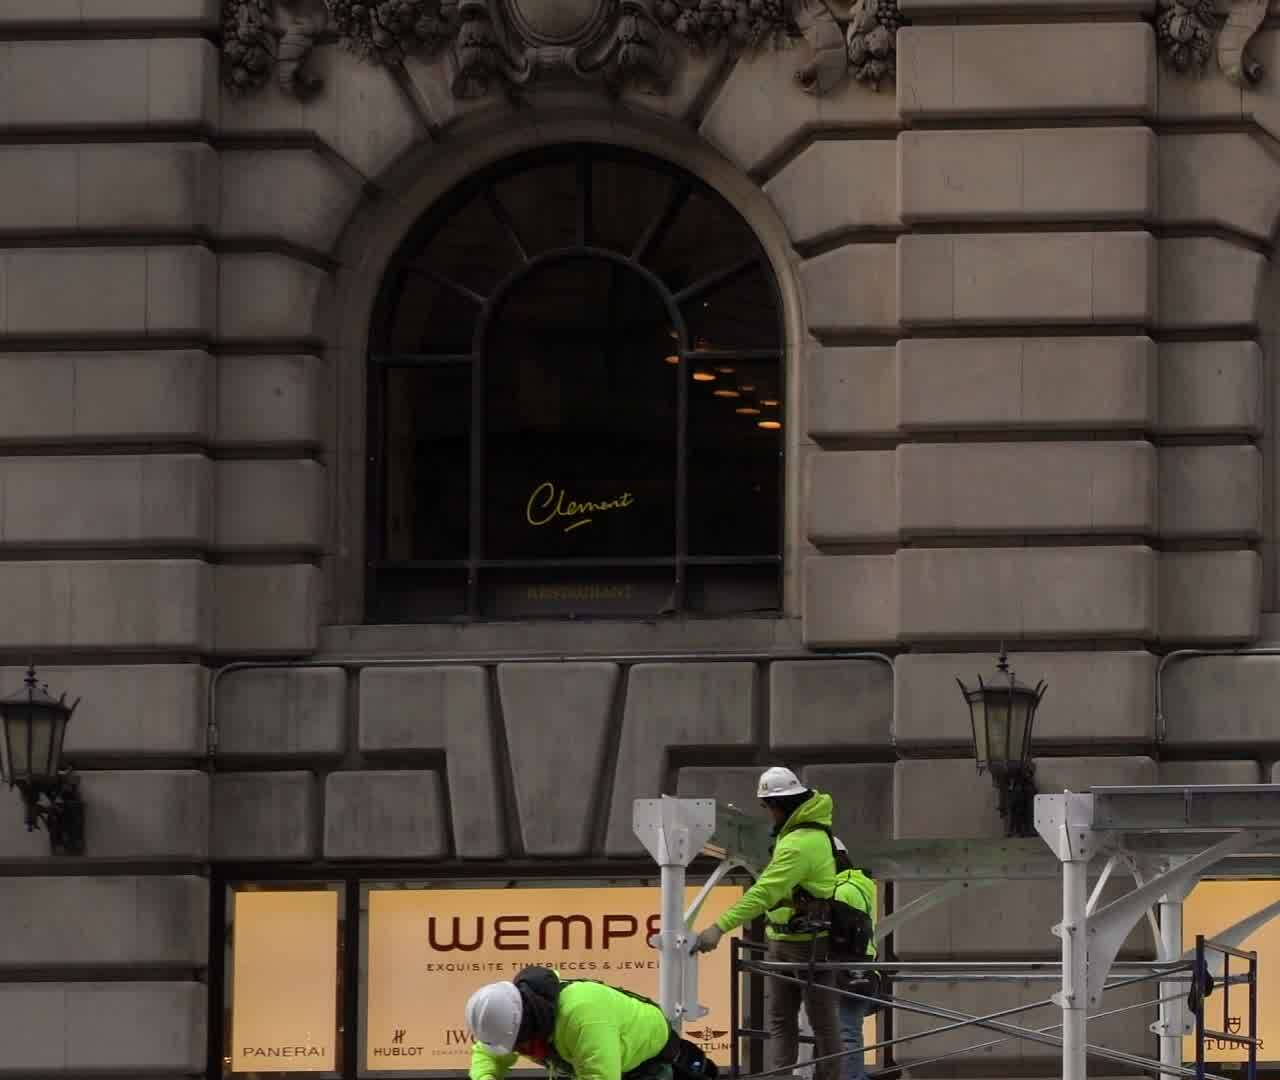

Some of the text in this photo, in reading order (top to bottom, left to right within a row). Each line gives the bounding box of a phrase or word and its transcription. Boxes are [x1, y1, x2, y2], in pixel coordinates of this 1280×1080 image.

[527, 482, 634, 526] Clement
[427, 962, 504, 972] EXQUISITE
[616, 960, 660, 970] JEWE
[242, 1047, 325, 1057] PANERAI
[373, 1047, 424, 1056] HUBLOT
